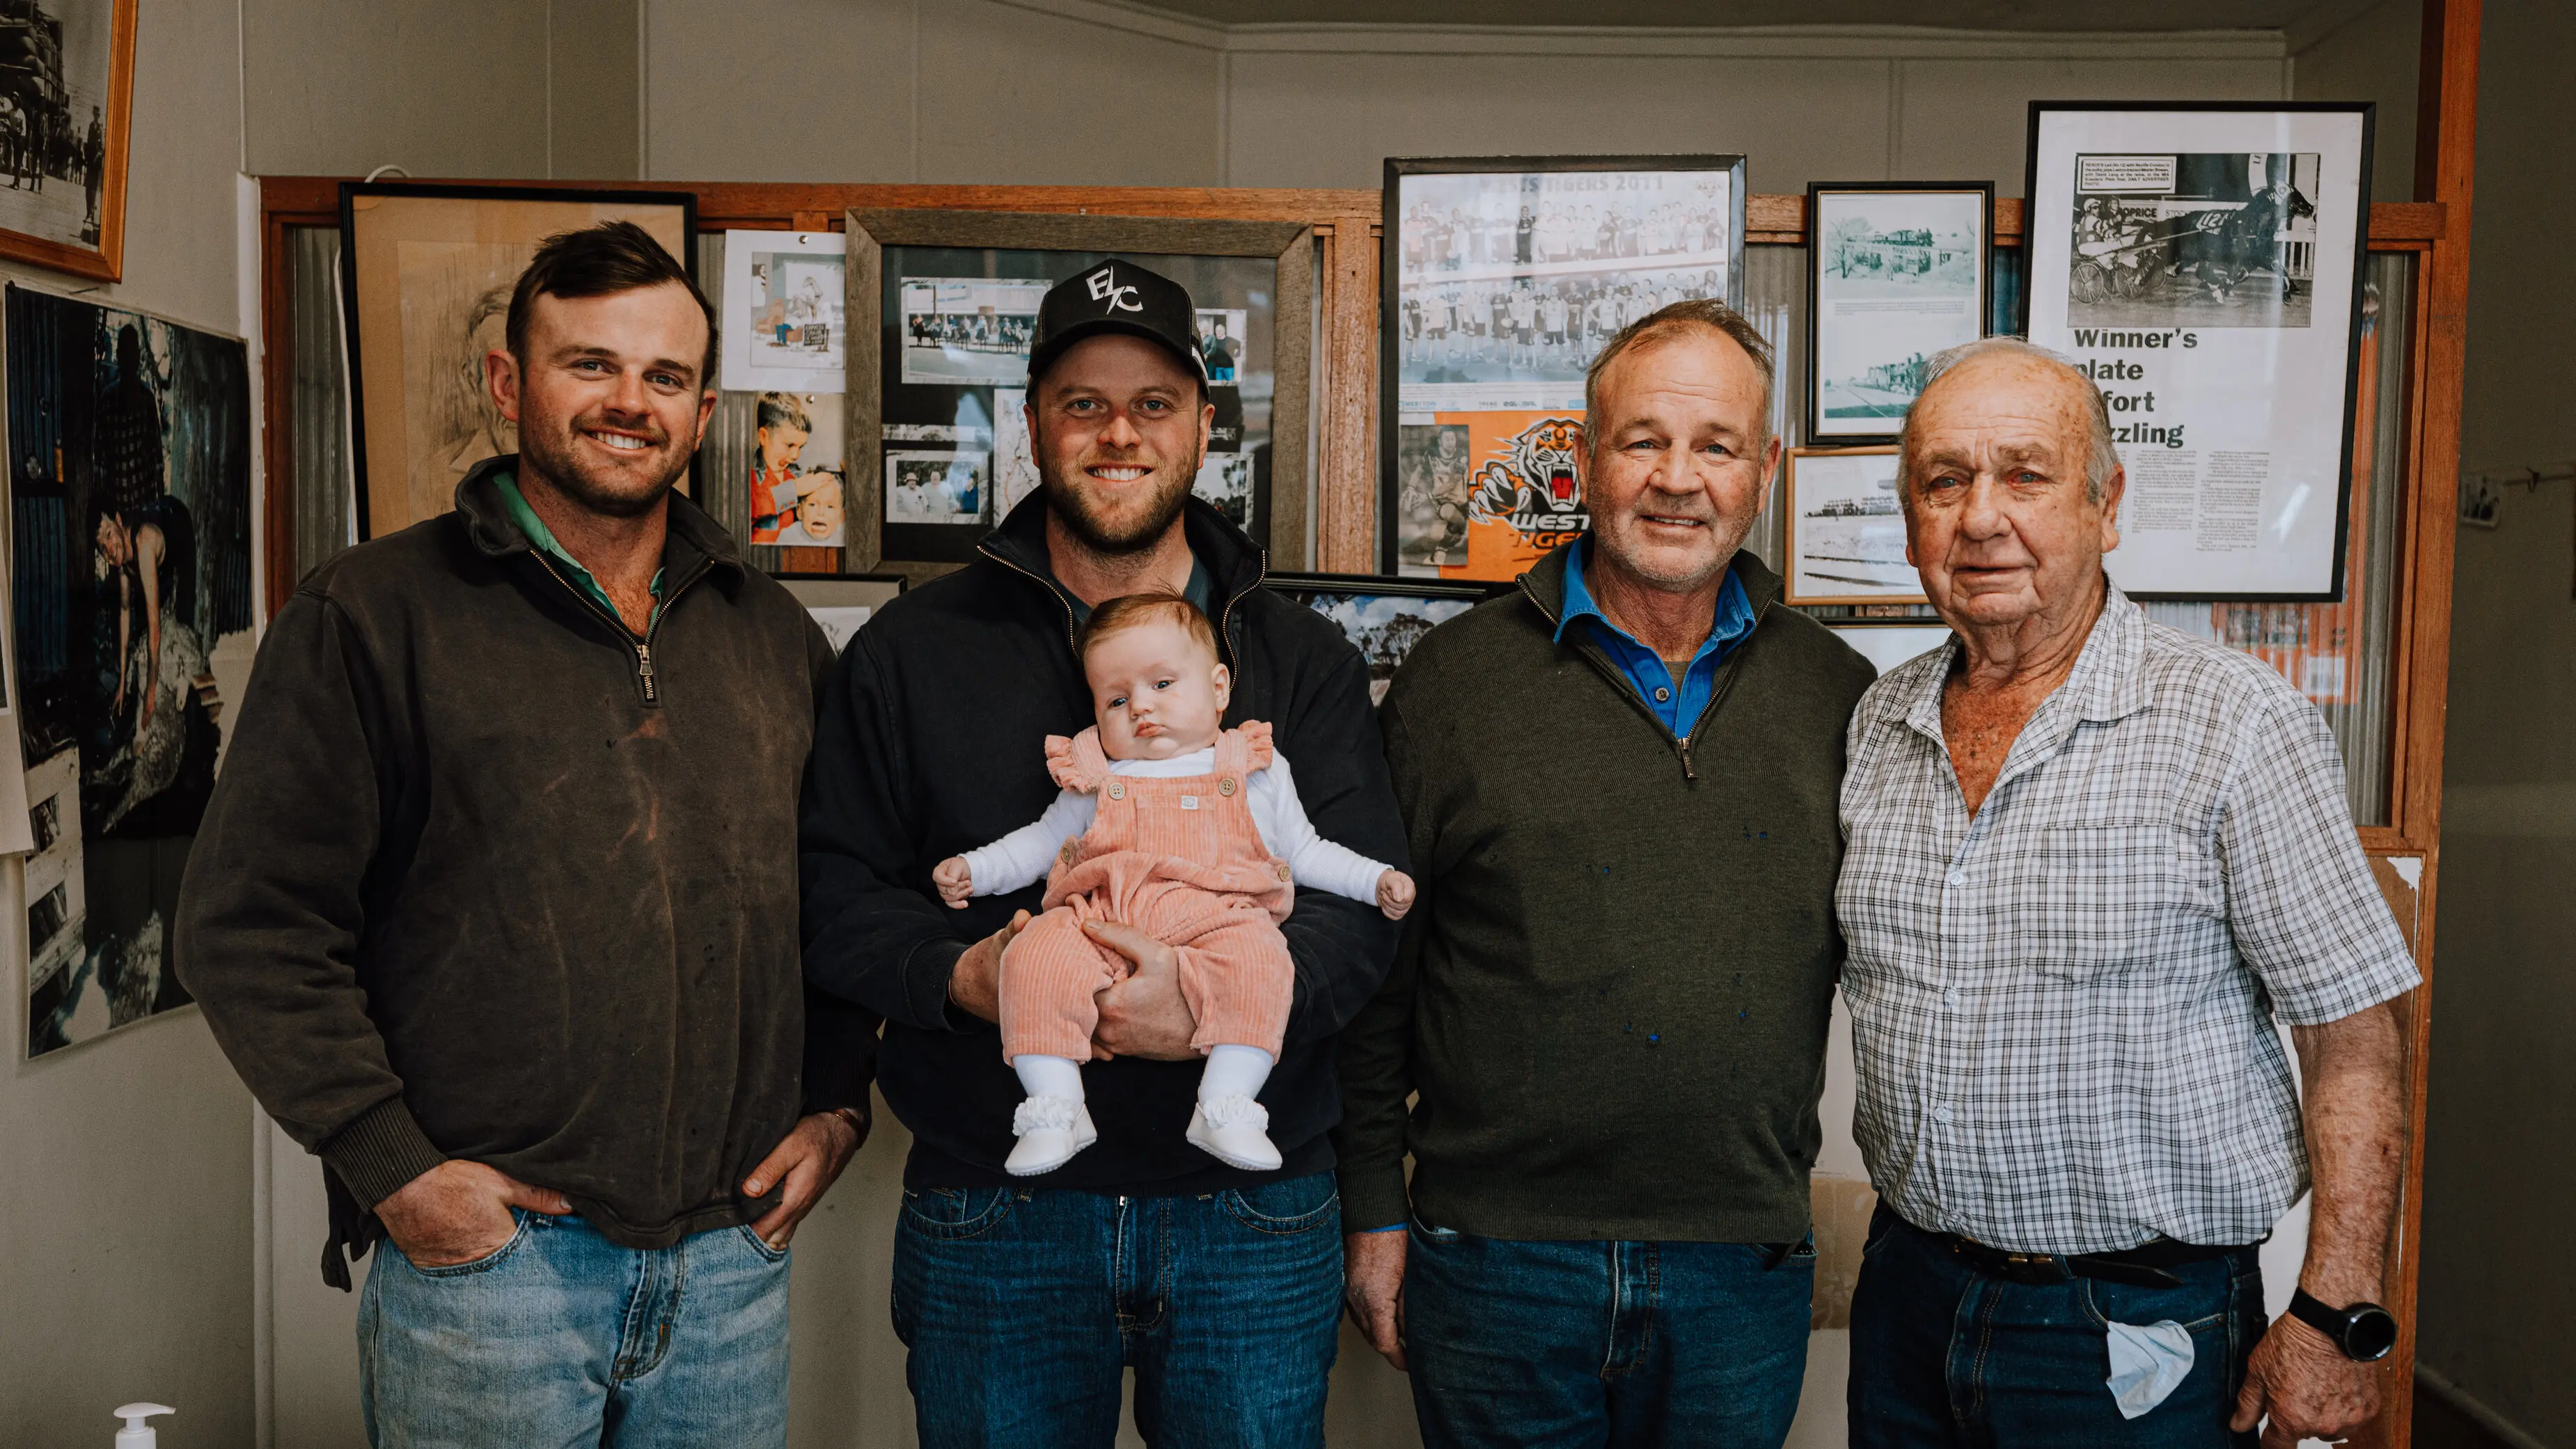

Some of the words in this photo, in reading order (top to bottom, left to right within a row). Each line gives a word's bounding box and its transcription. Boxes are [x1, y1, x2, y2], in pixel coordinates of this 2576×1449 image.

[1545, 175, 1610, 191] TIGERS
[1615, 175, 1663, 191] 2011
[2074, 327, 2198, 348] Winner's
[2103, 391, 2155, 412] fort
[1510, 513, 1590, 531] WEST
[1509, 531, 1582, 548] TIGE
